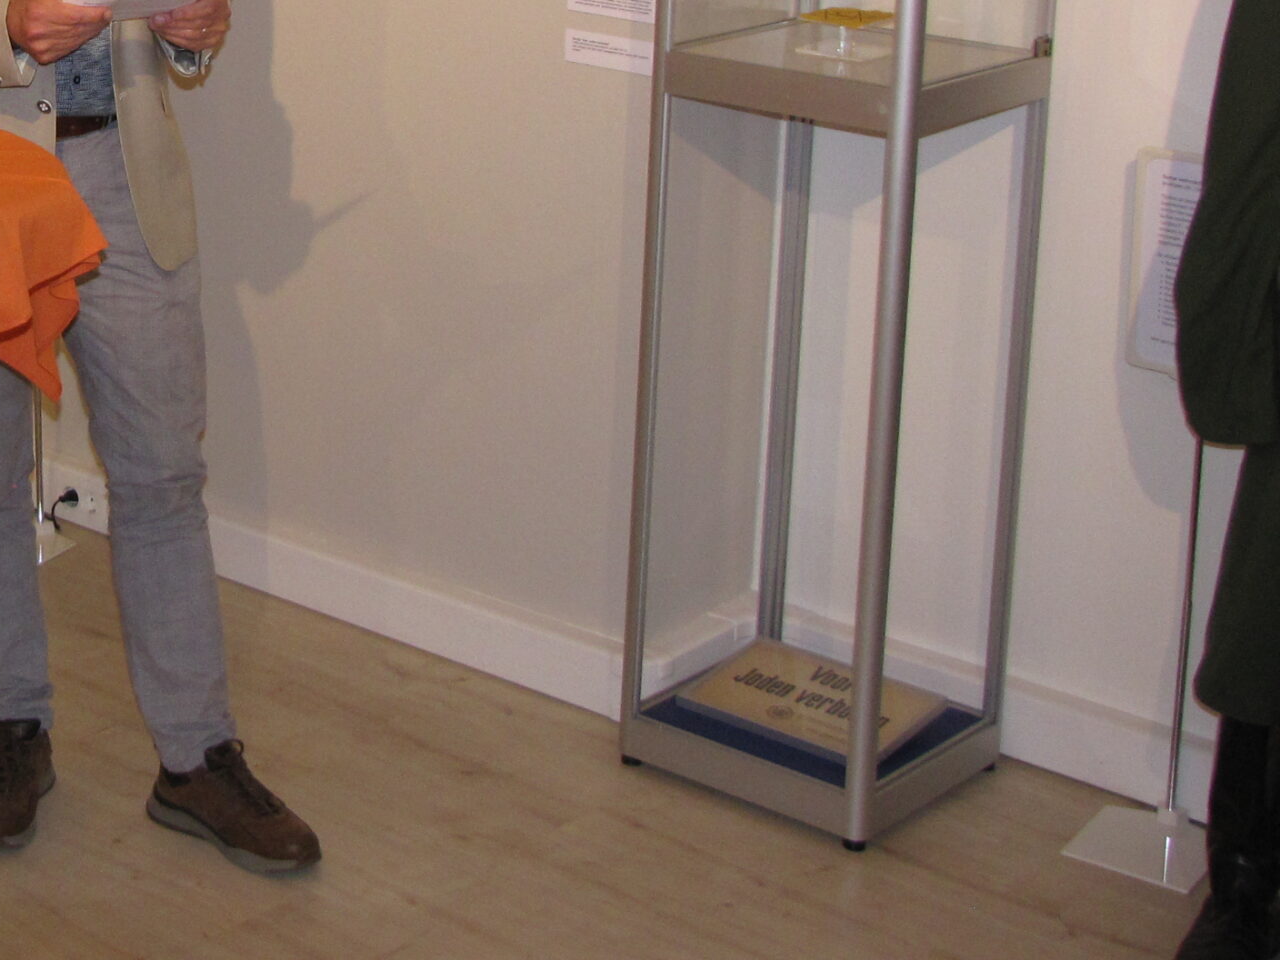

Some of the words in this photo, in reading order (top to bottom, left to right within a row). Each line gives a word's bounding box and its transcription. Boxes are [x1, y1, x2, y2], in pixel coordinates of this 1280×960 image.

[734, 668, 796, 697] Joden
[795, 690, 890, 729] verbon
[809, 665, 852, 692] Voor
